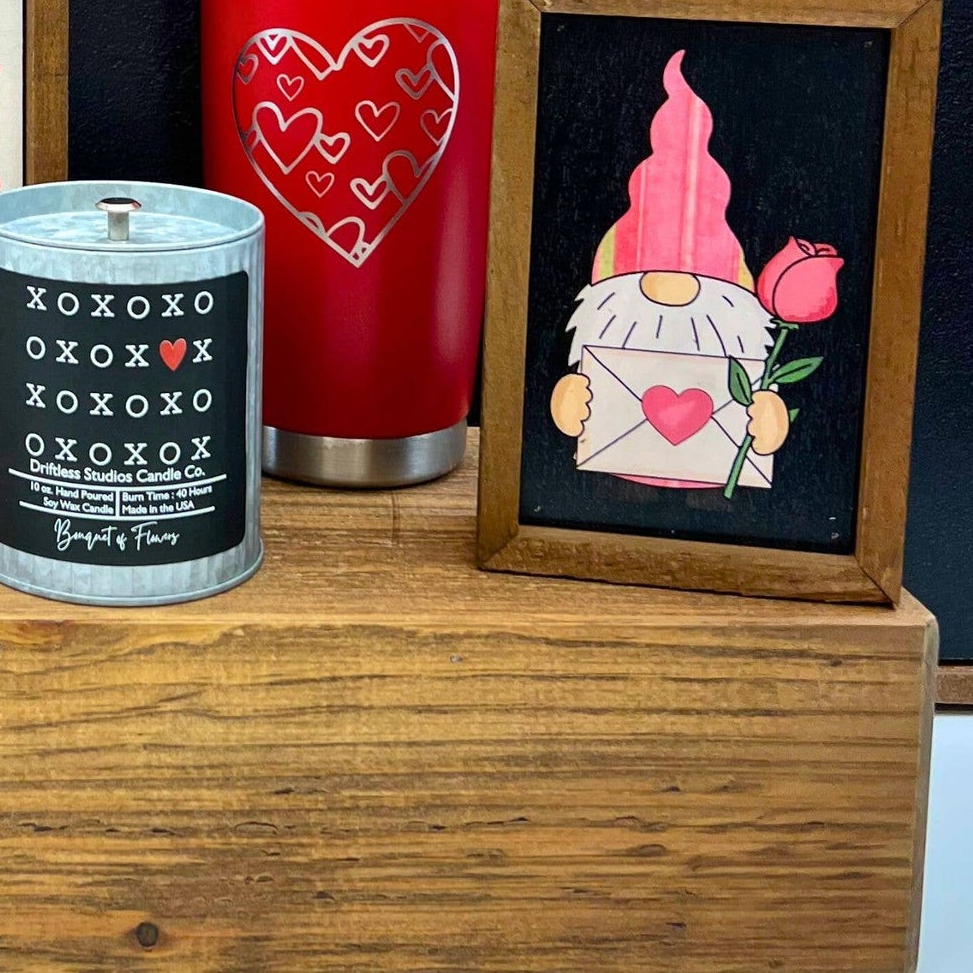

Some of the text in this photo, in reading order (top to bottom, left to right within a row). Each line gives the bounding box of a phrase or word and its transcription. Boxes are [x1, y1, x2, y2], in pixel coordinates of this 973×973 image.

[30, 458, 206, 483] Driftless Studios Candle Co.
[30, 481, 114, 502] 10 oz. Hand Poured
[122, 492, 144, 502] Burn
[146, 491, 170, 501] Time
[176, 488, 188, 499] 40
[188, 485, 212, 497] Hours
[43, 496, 114, 515] Soy Wax Candle
[122, 500, 195, 515] Made in the USA
[116, 533, 127, 551] of
